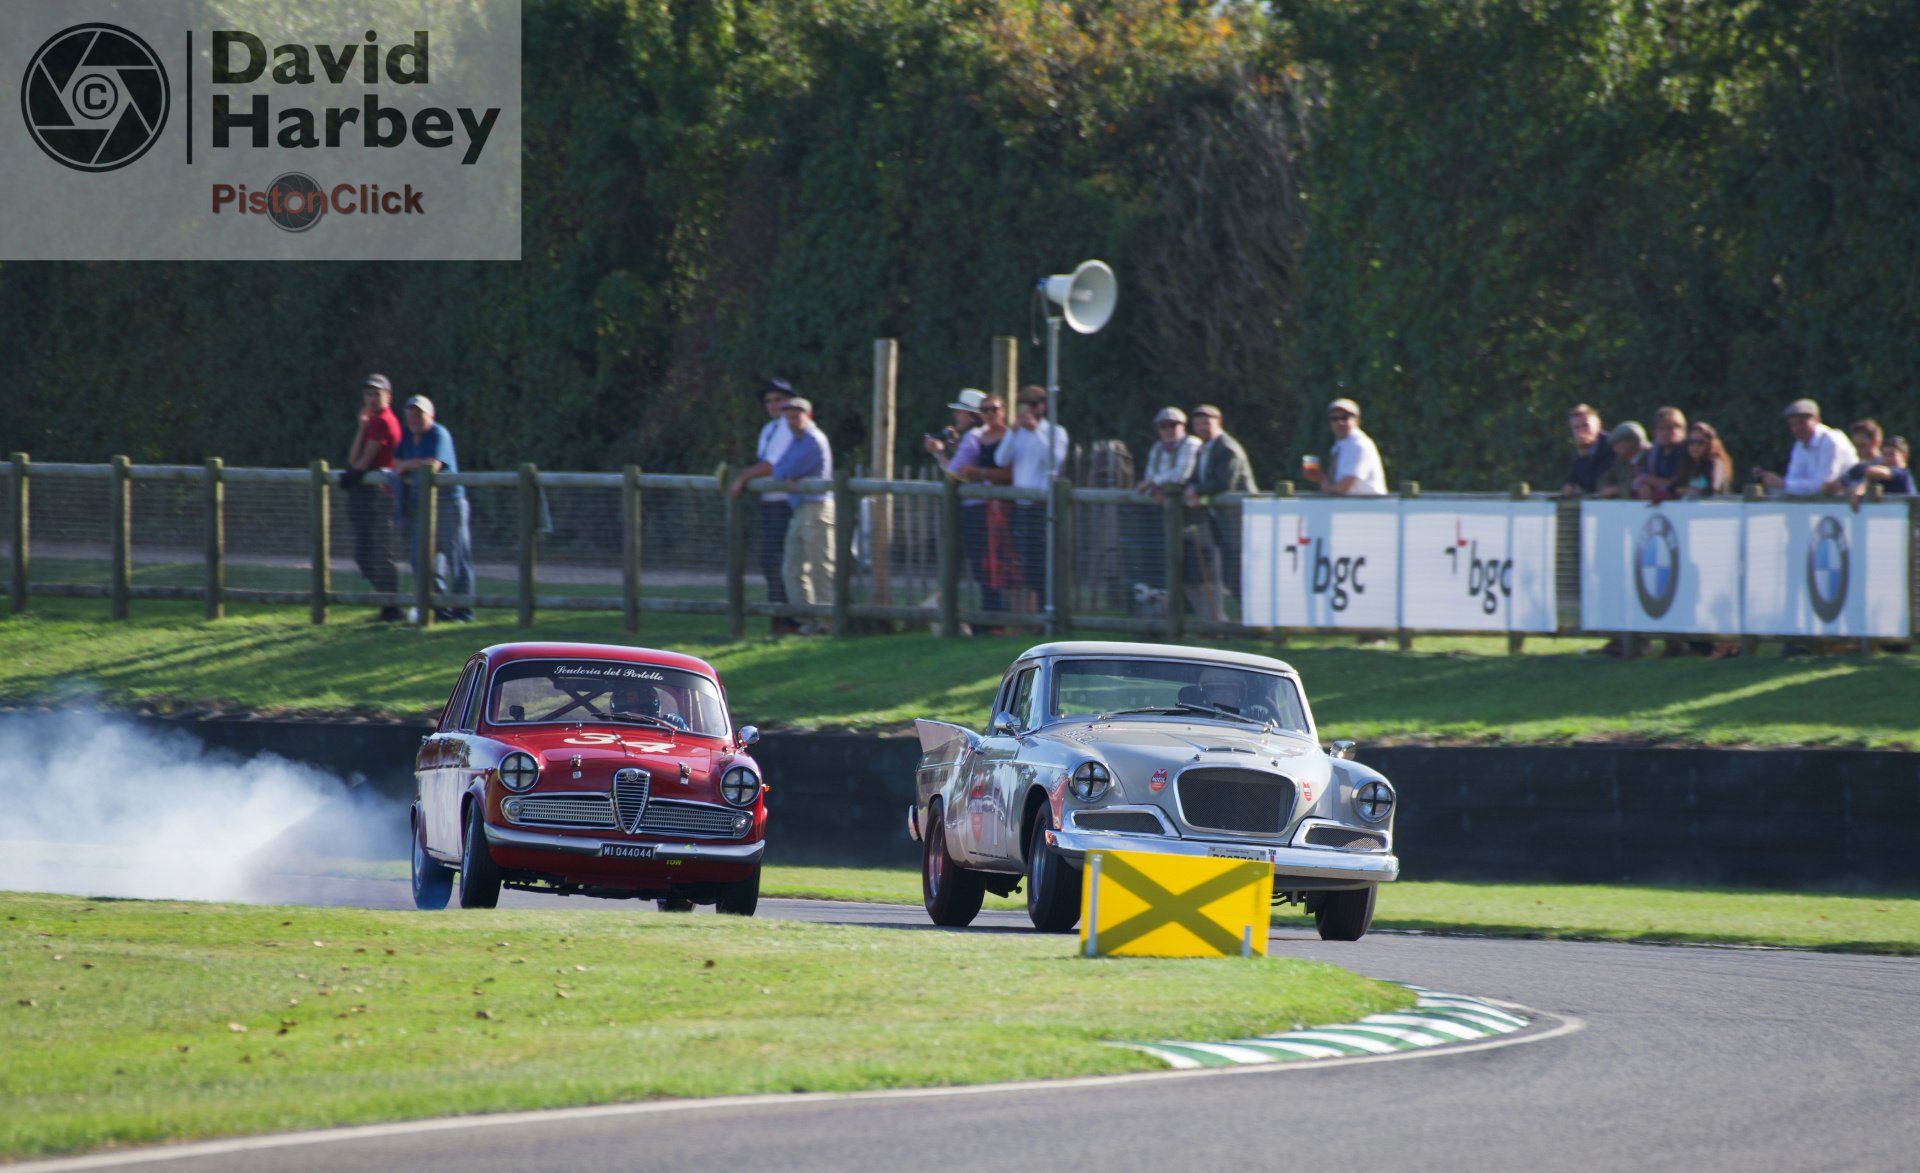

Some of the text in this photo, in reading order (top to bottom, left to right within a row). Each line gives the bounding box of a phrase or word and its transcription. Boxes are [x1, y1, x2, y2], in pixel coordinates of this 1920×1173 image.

[1313, 537, 1366, 611] bgc
[1468, 540, 1514, 614] bgc
[554, 665, 664, 681] Scuderia del Portello
[563, 732, 677, 753] 34
[615, 847, 651, 858] 044044
